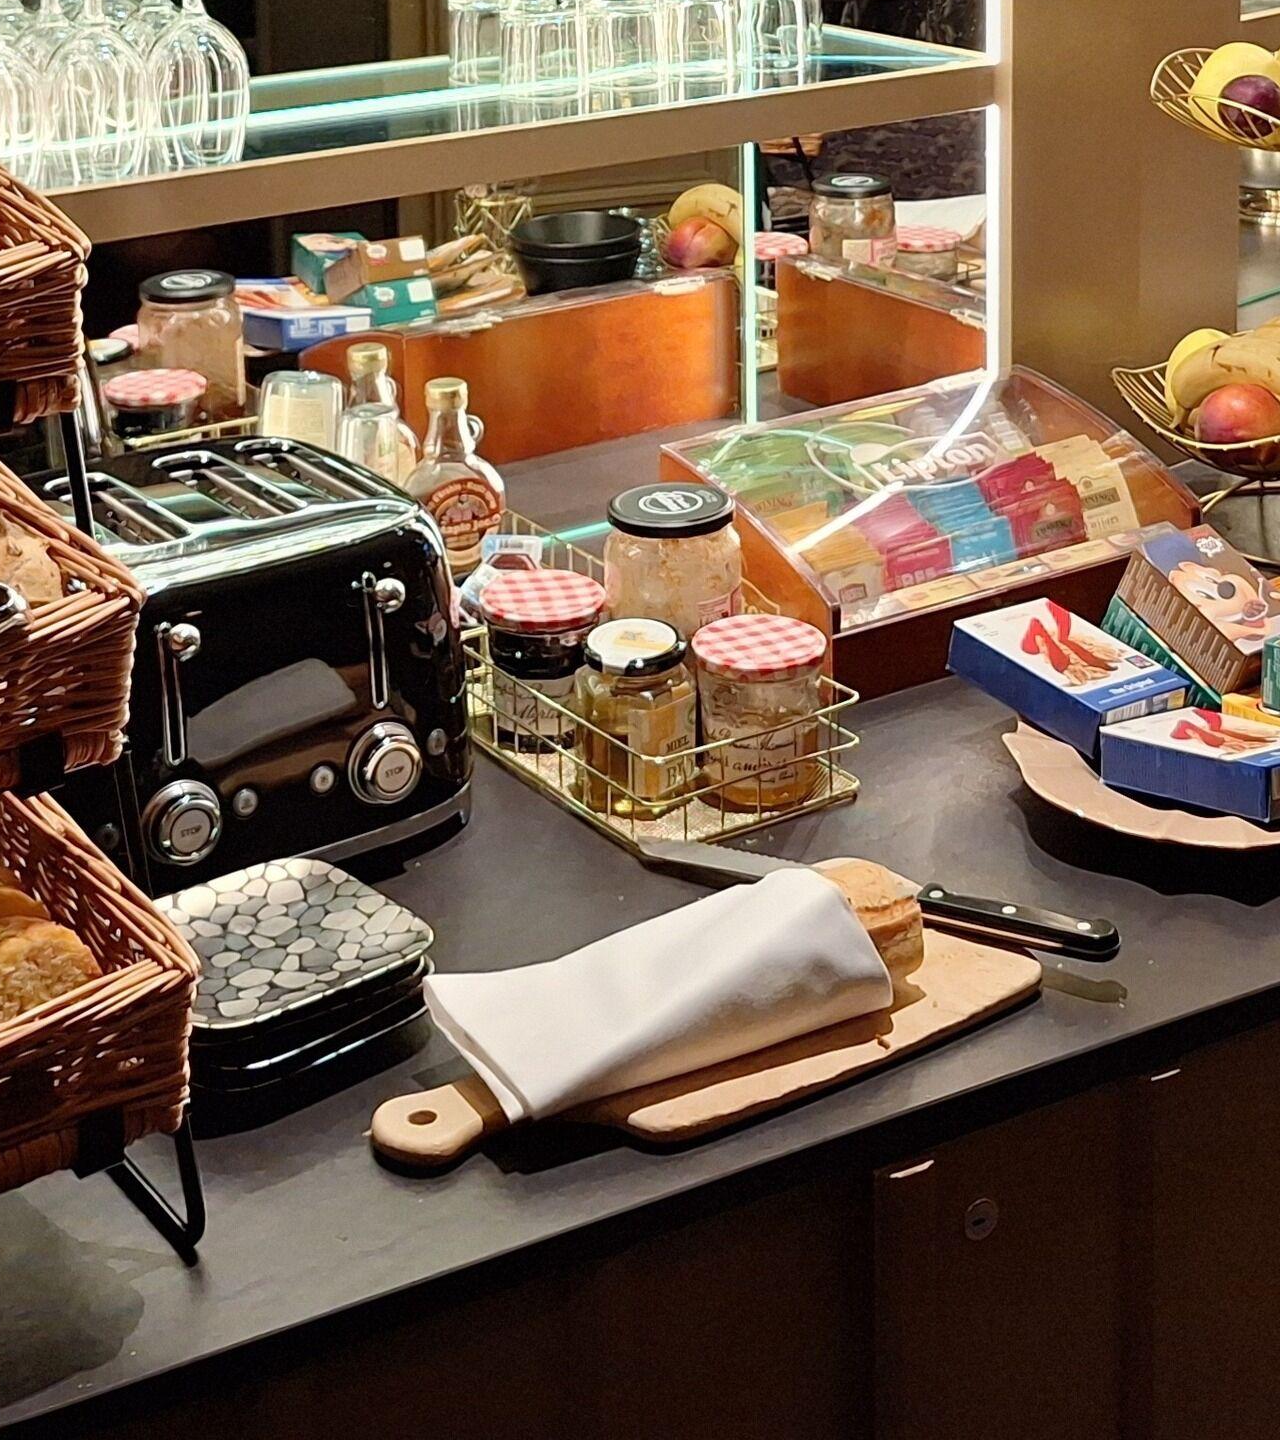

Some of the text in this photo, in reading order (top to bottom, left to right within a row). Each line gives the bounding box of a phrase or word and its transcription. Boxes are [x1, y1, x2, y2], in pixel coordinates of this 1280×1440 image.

[869, 443, 996, 484] Lipton
[384, 765, 406, 779] STOP
[180, 824, 203, 838] STOP
